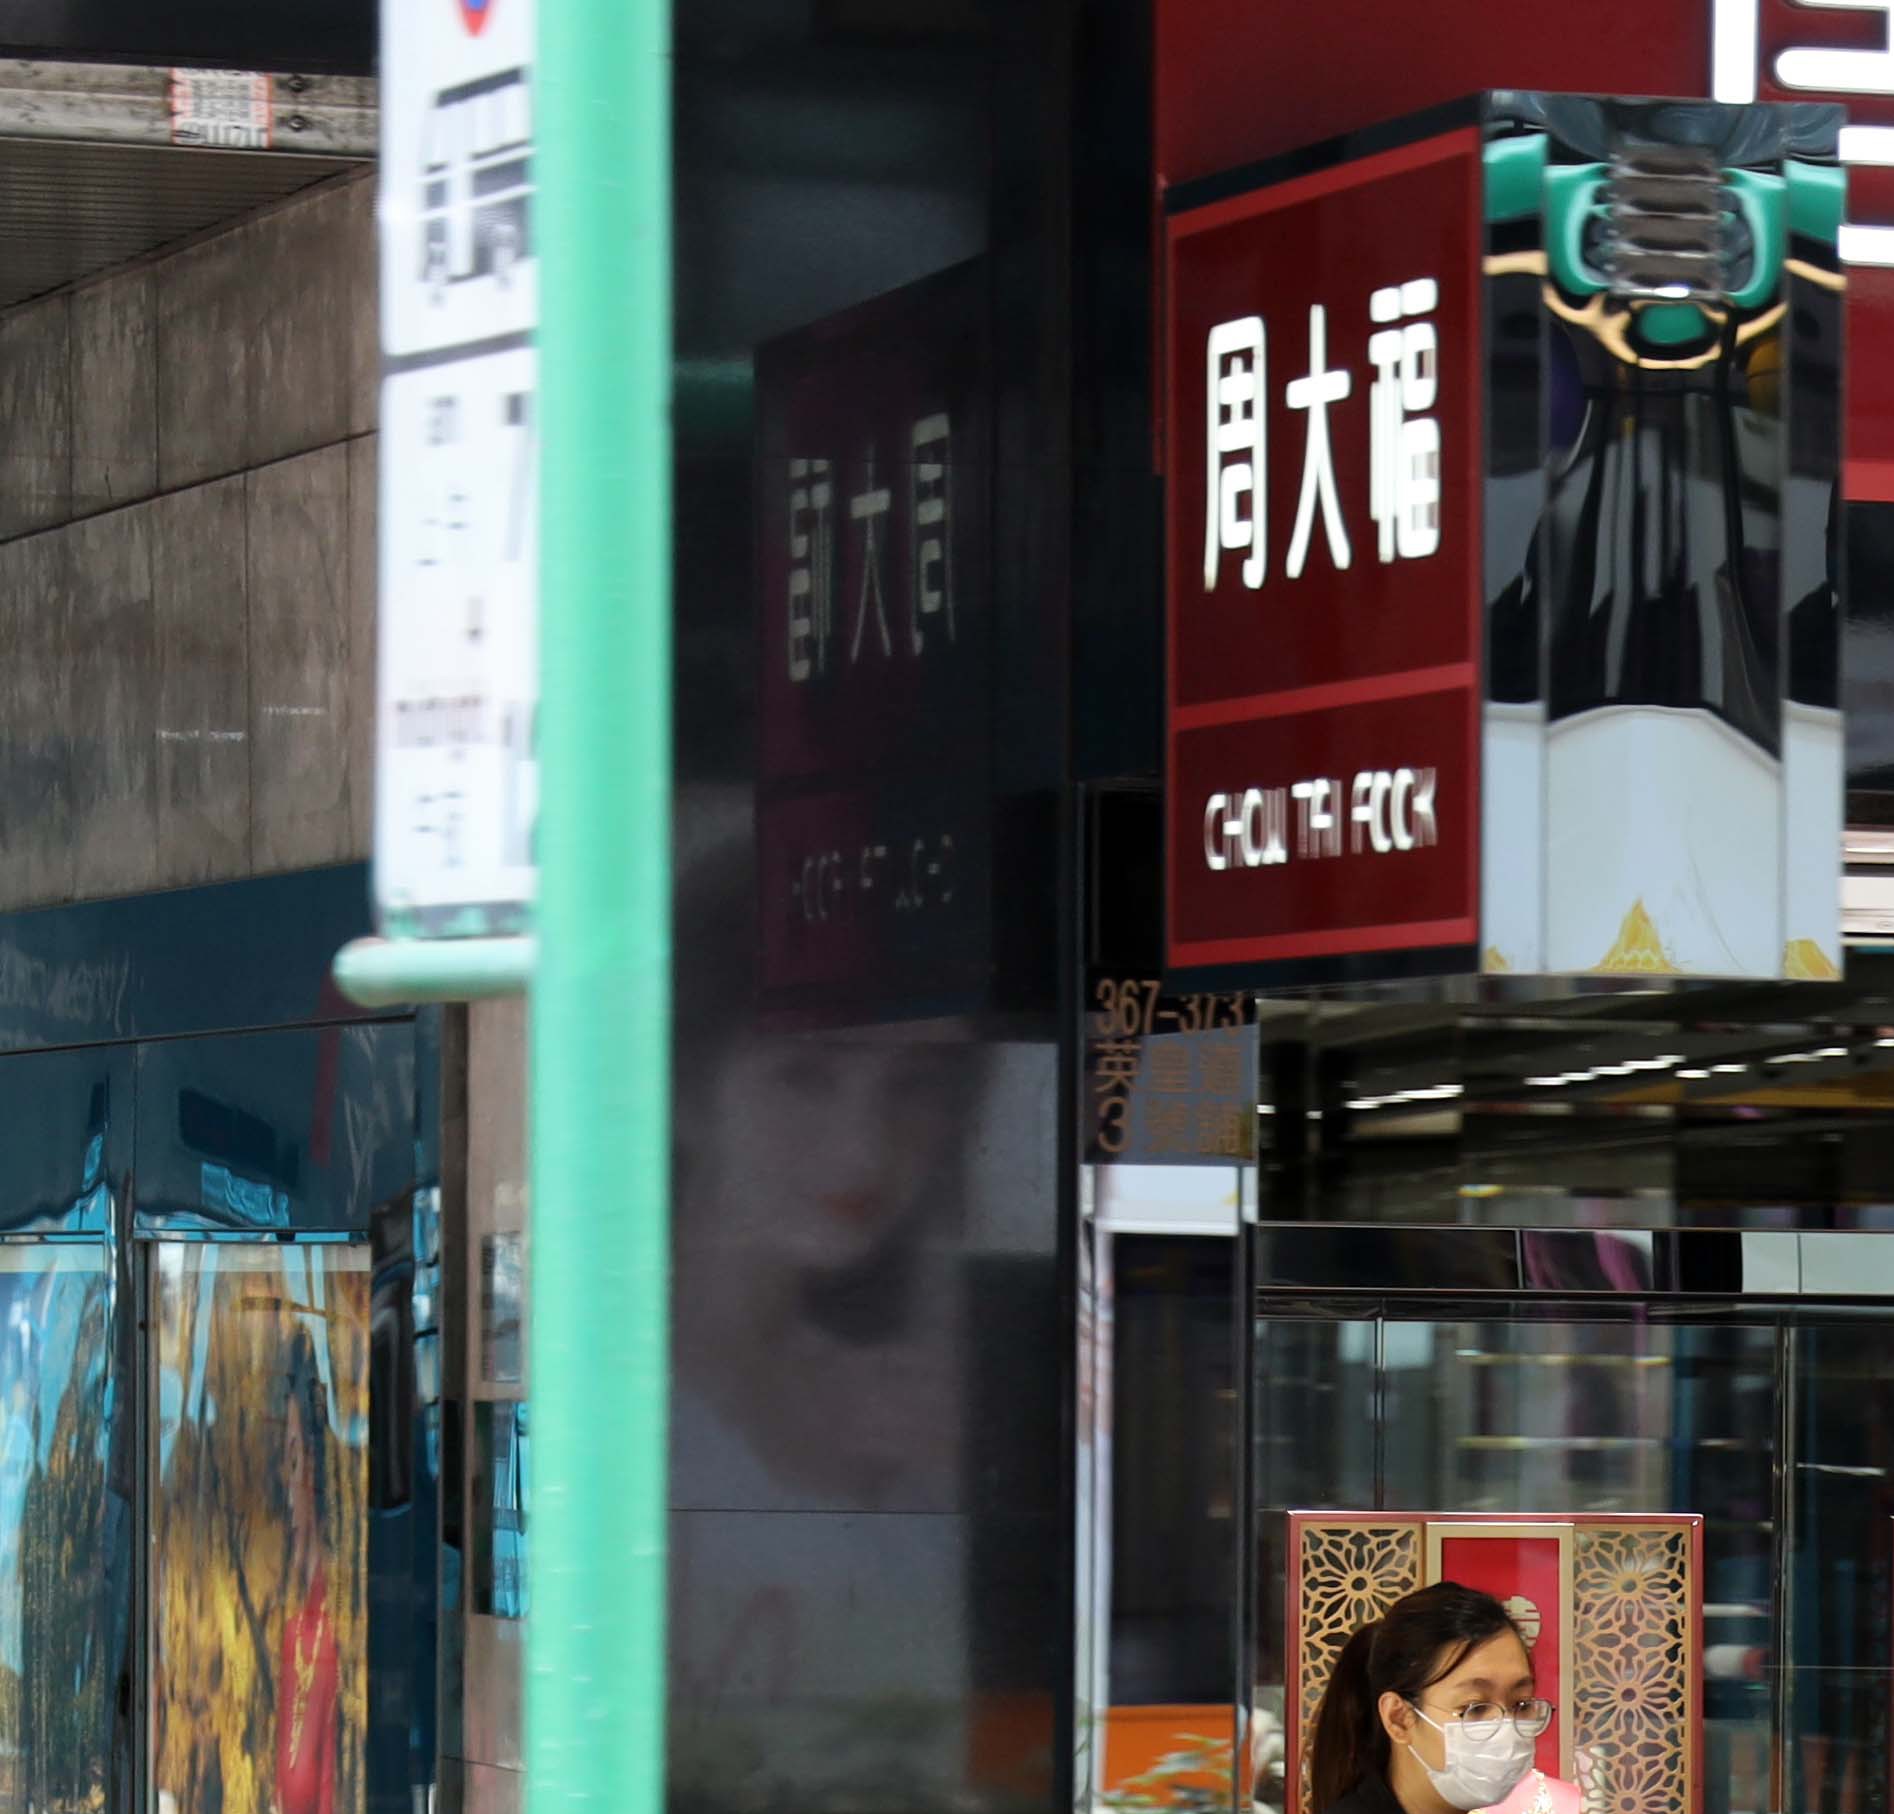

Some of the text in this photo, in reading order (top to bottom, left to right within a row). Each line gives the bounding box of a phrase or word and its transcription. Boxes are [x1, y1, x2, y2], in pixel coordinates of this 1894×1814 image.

[1204, 277, 1440, 593] 周大福
[1203, 766, 1437, 871] CHOW TAI FOOK
[1096, 978, 1247, 1037] 367-373
